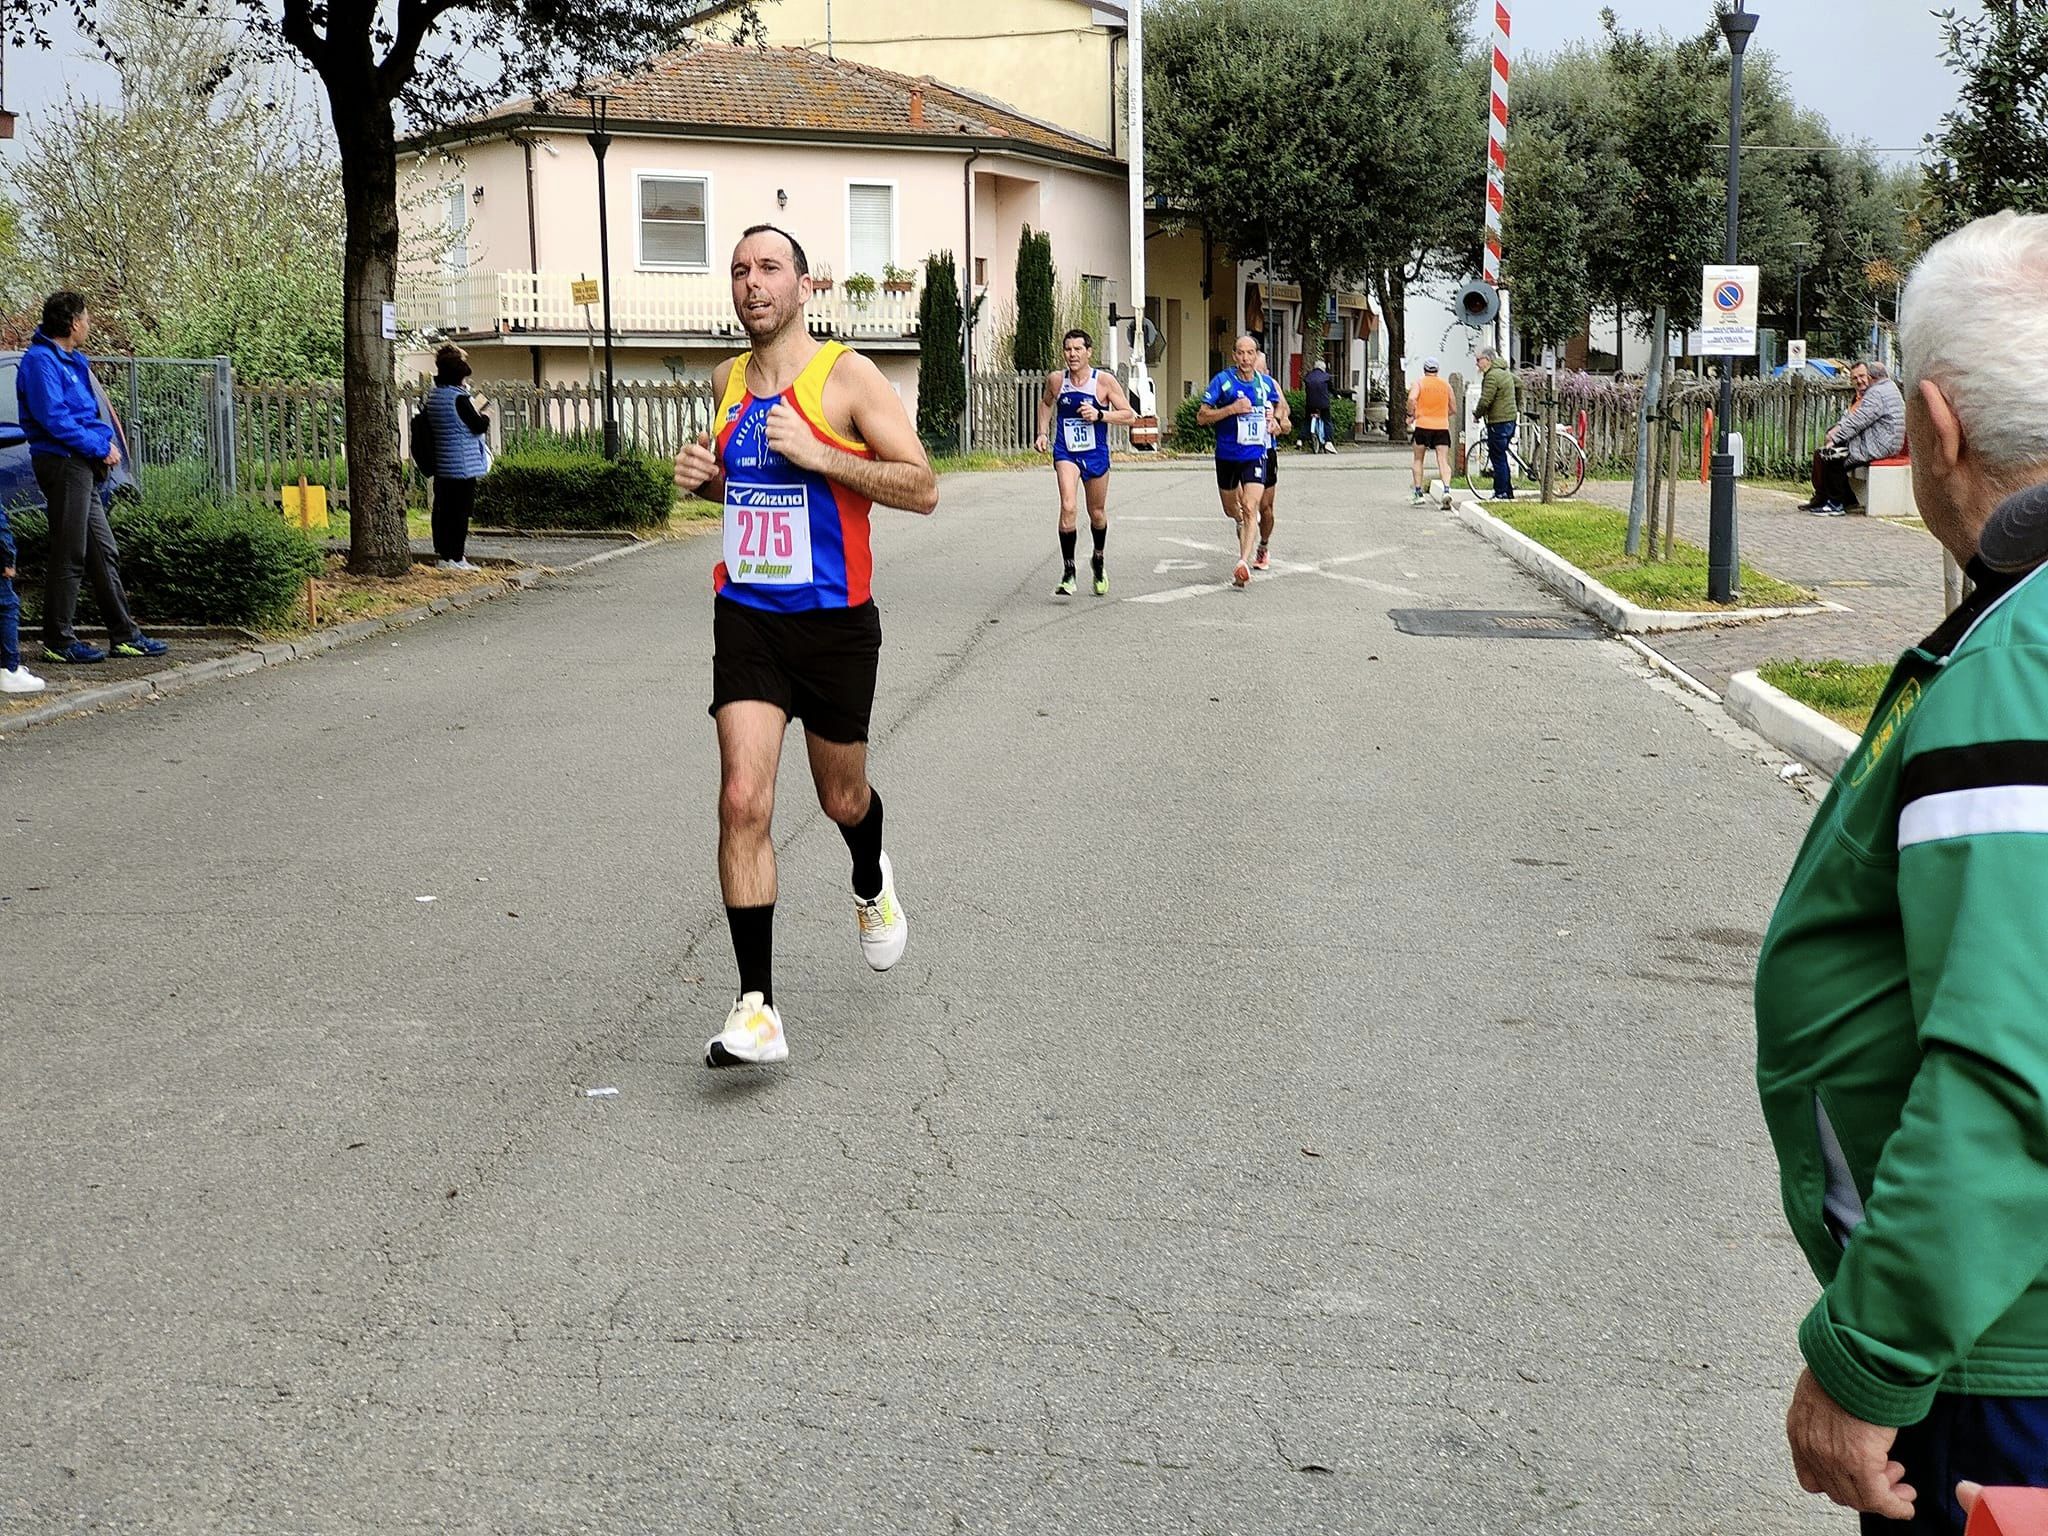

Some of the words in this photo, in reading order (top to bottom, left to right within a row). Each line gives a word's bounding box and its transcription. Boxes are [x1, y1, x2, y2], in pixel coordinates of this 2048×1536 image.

[1264, 286, 1299, 299] TBACCHERIA
[736, 408, 765, 447] ATLETIC
[1073, 426, 1088, 443] 35
[1248, 422, 1258, 436] 19
[738, 510, 793, 557] 275
